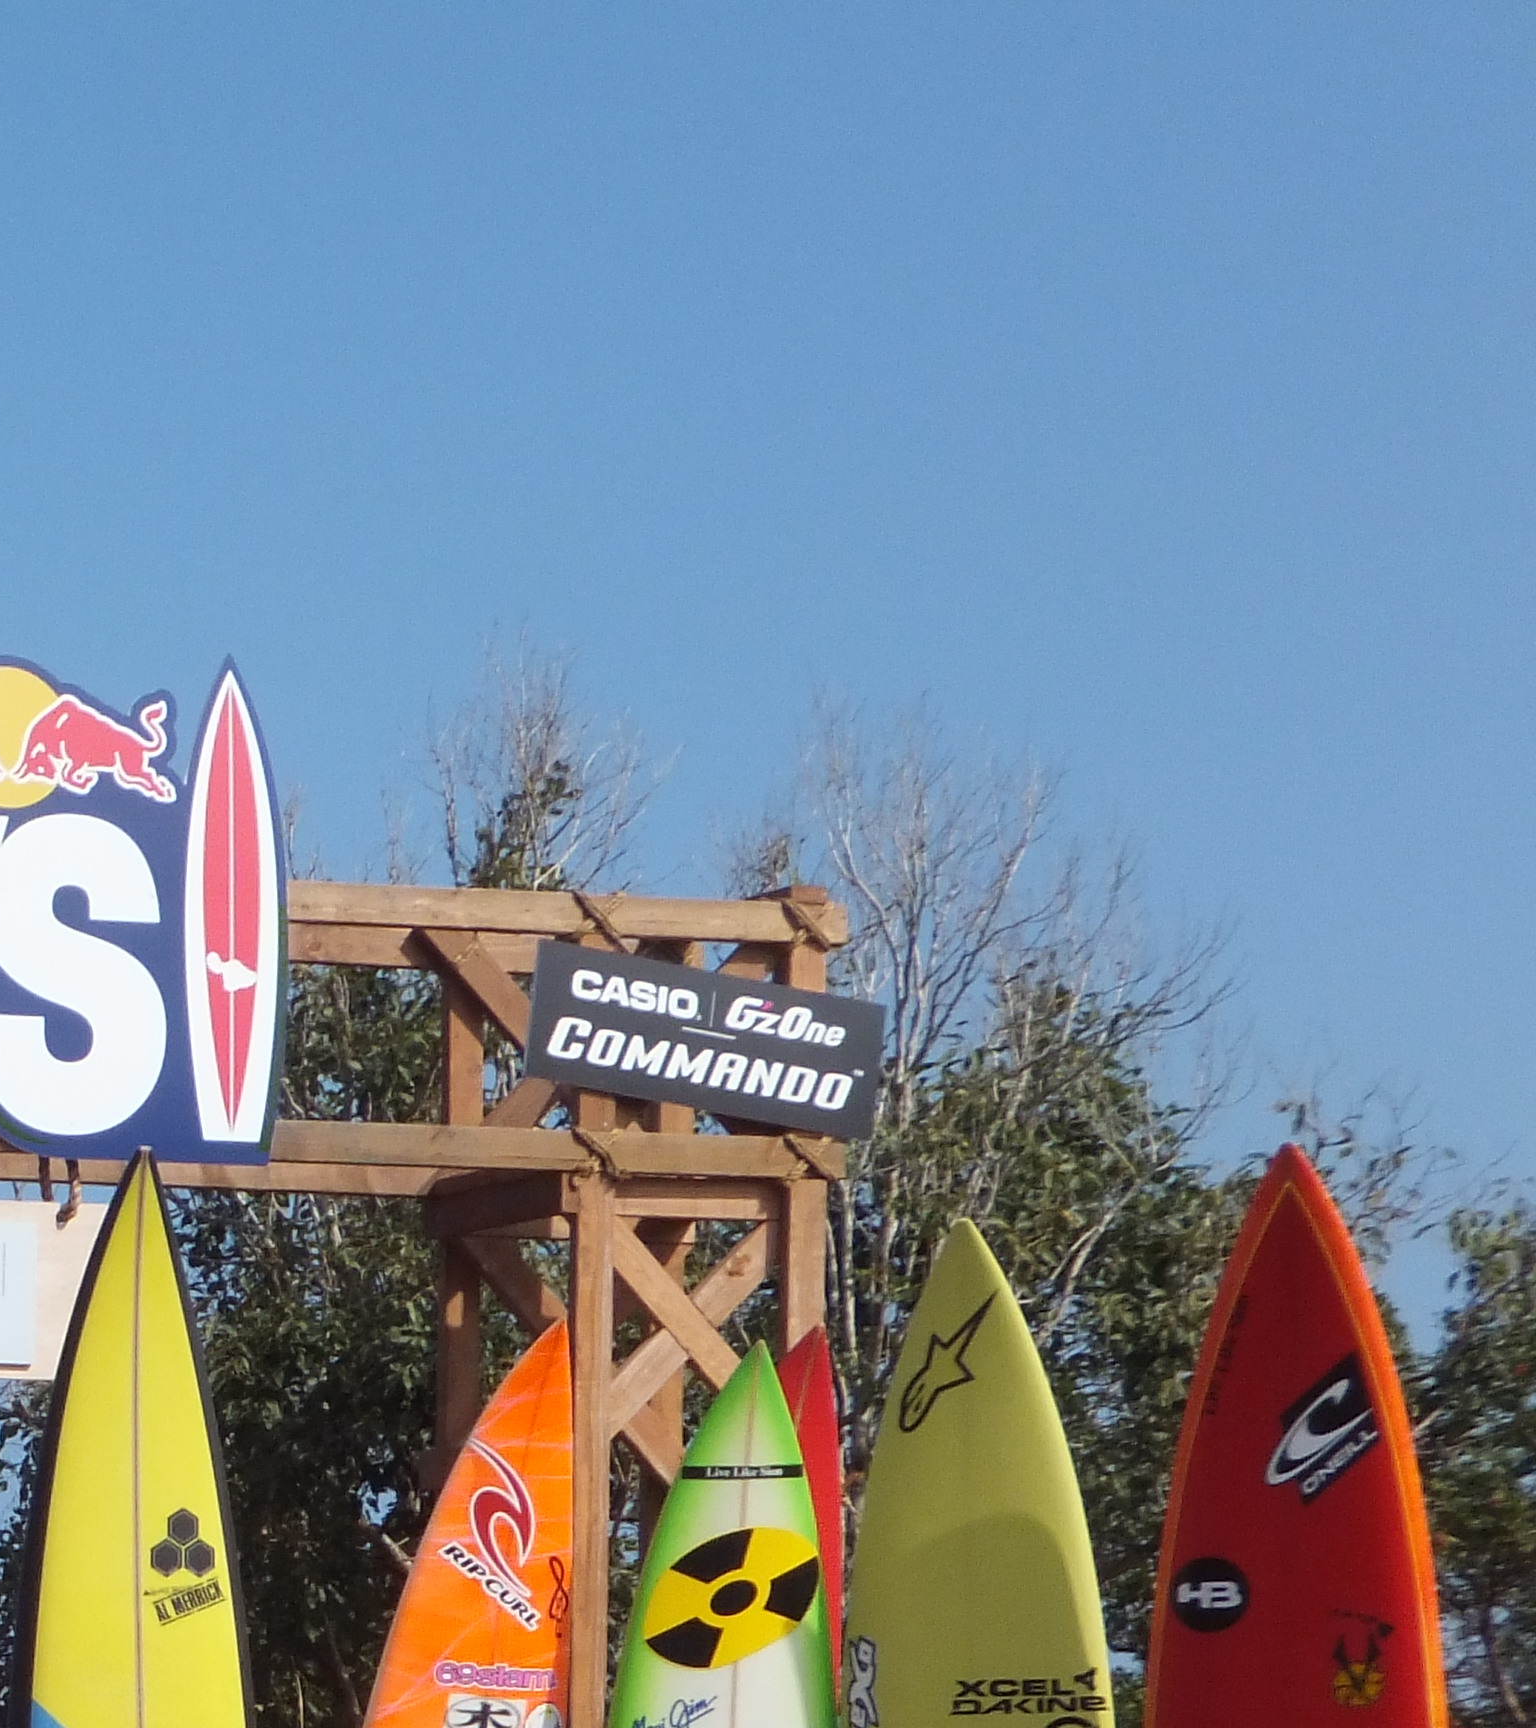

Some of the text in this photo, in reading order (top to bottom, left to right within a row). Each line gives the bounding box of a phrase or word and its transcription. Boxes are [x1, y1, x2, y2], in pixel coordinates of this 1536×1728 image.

[571, 968, 701, 1021] CASIO
[546, 1016, 854, 1112] COMMANDO
[949, 1695, 1109, 1716] DAKINE
